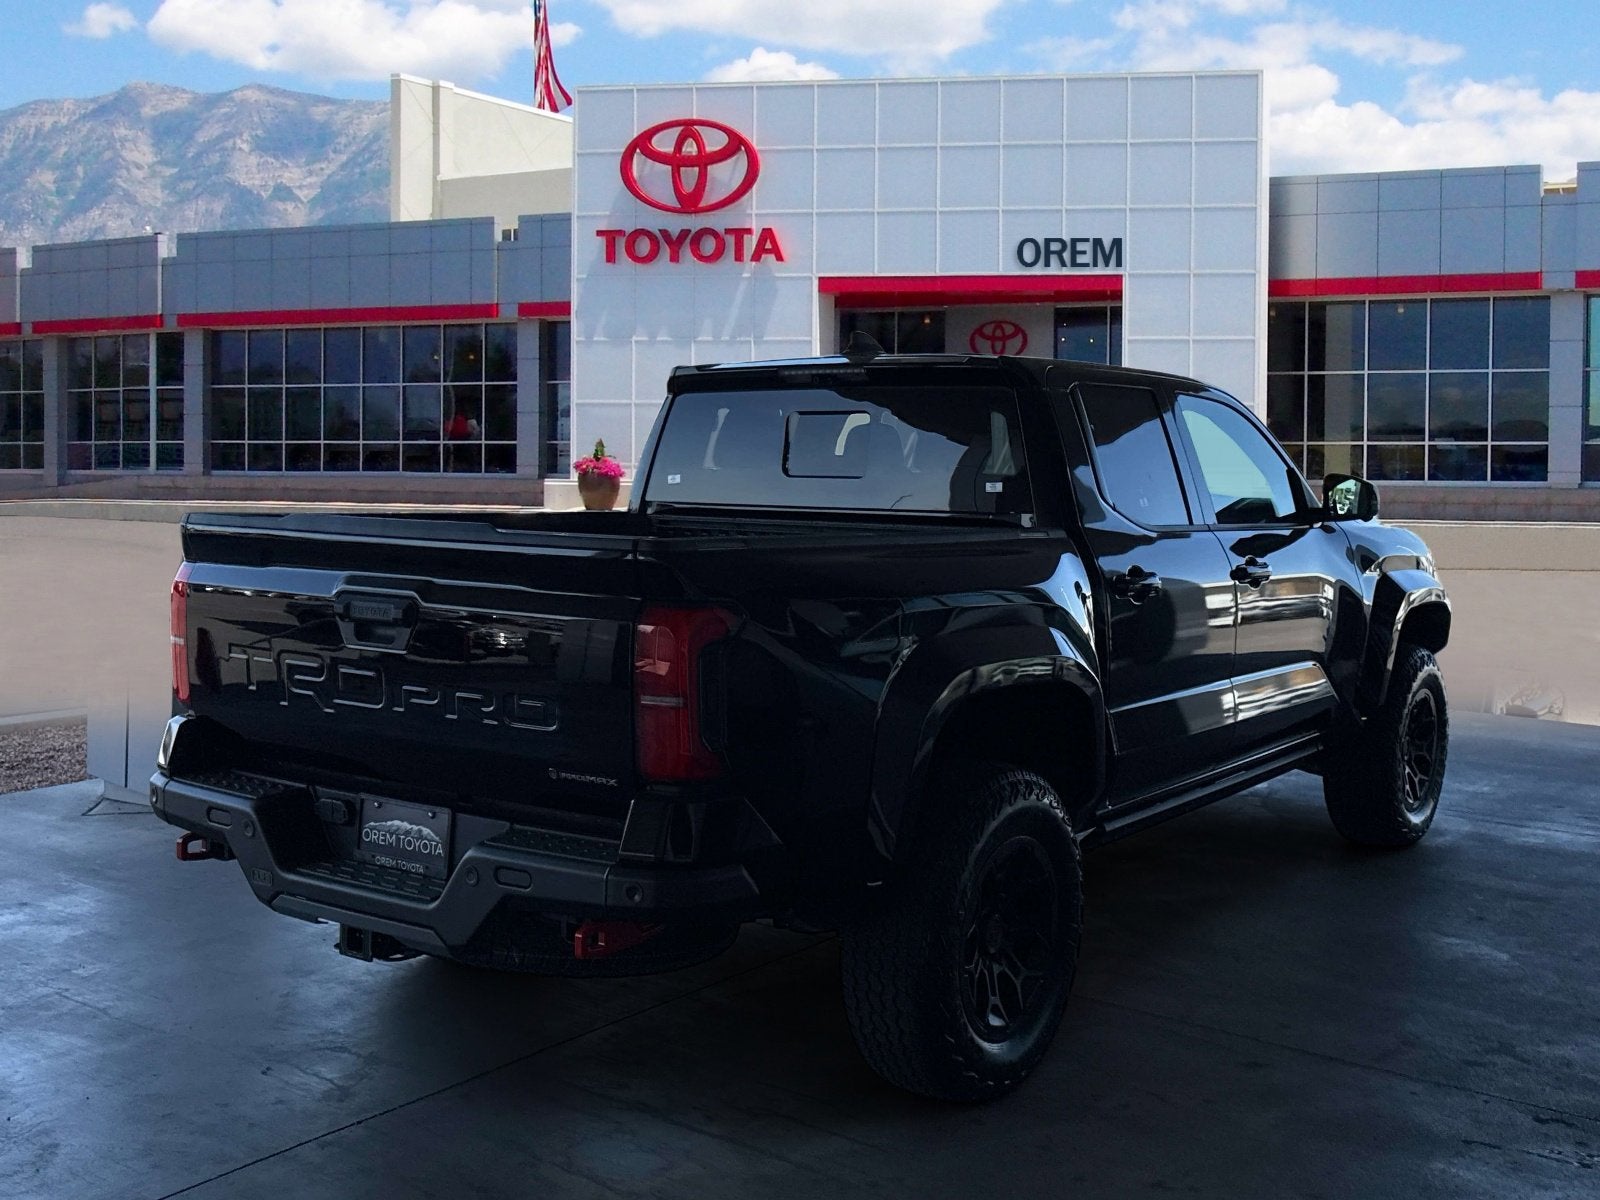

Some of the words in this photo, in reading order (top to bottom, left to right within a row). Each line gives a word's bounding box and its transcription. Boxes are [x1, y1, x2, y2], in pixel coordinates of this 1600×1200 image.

[596, 228, 784, 264] TOYOTA
[1017, 237, 1122, 268] OREM
[229, 644, 386, 713] TRD
[392, 681, 560, 731] PRO
[362, 828, 396, 847] OREM
[398, 835, 444, 857] TOYOTA
[375, 856, 396, 868] OREM
[397, 859, 424, 873] TOYOTA
